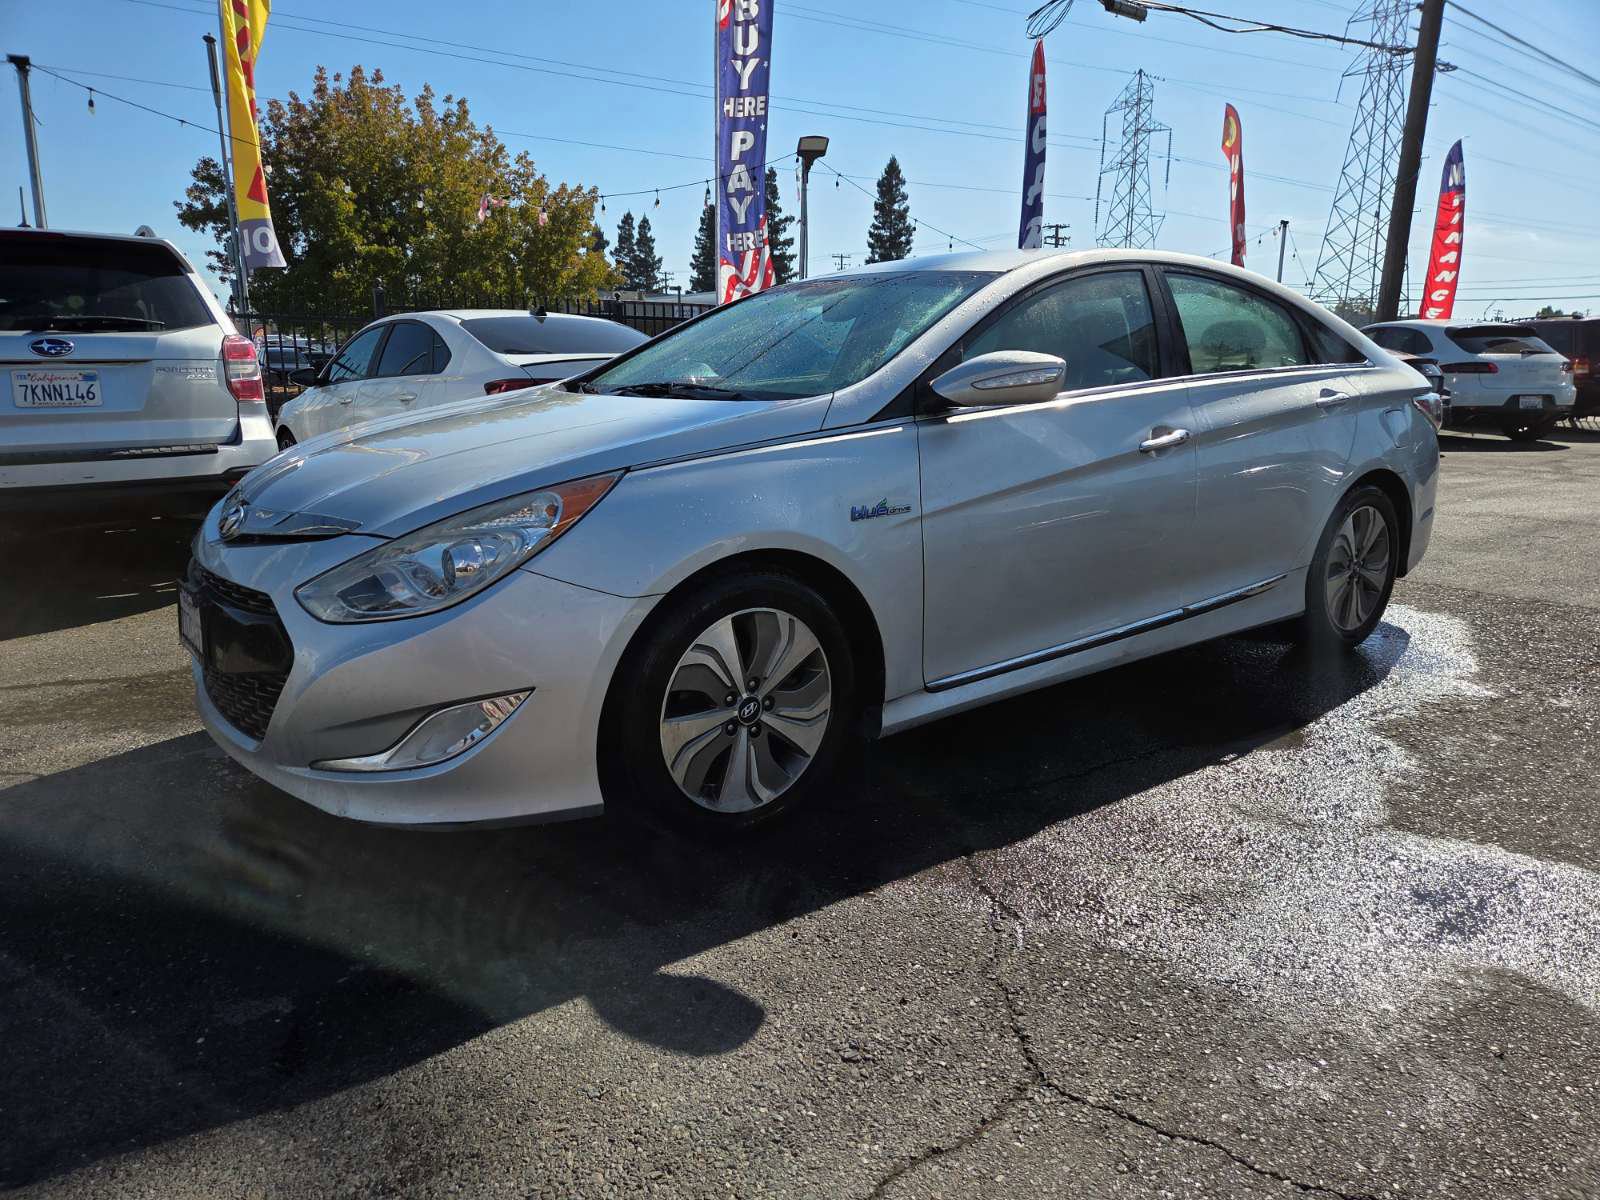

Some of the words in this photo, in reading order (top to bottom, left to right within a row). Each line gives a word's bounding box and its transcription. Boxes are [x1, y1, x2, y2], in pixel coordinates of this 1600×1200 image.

[731, 0, 760, 90] BUY
[724, 96, 766, 118] HERE
[727, 131, 755, 224] PAY
[726, 229, 765, 252] HERE
[1425, 193, 1464, 318] FINANCE
[18, 383, 97, 402] 7KNN146
